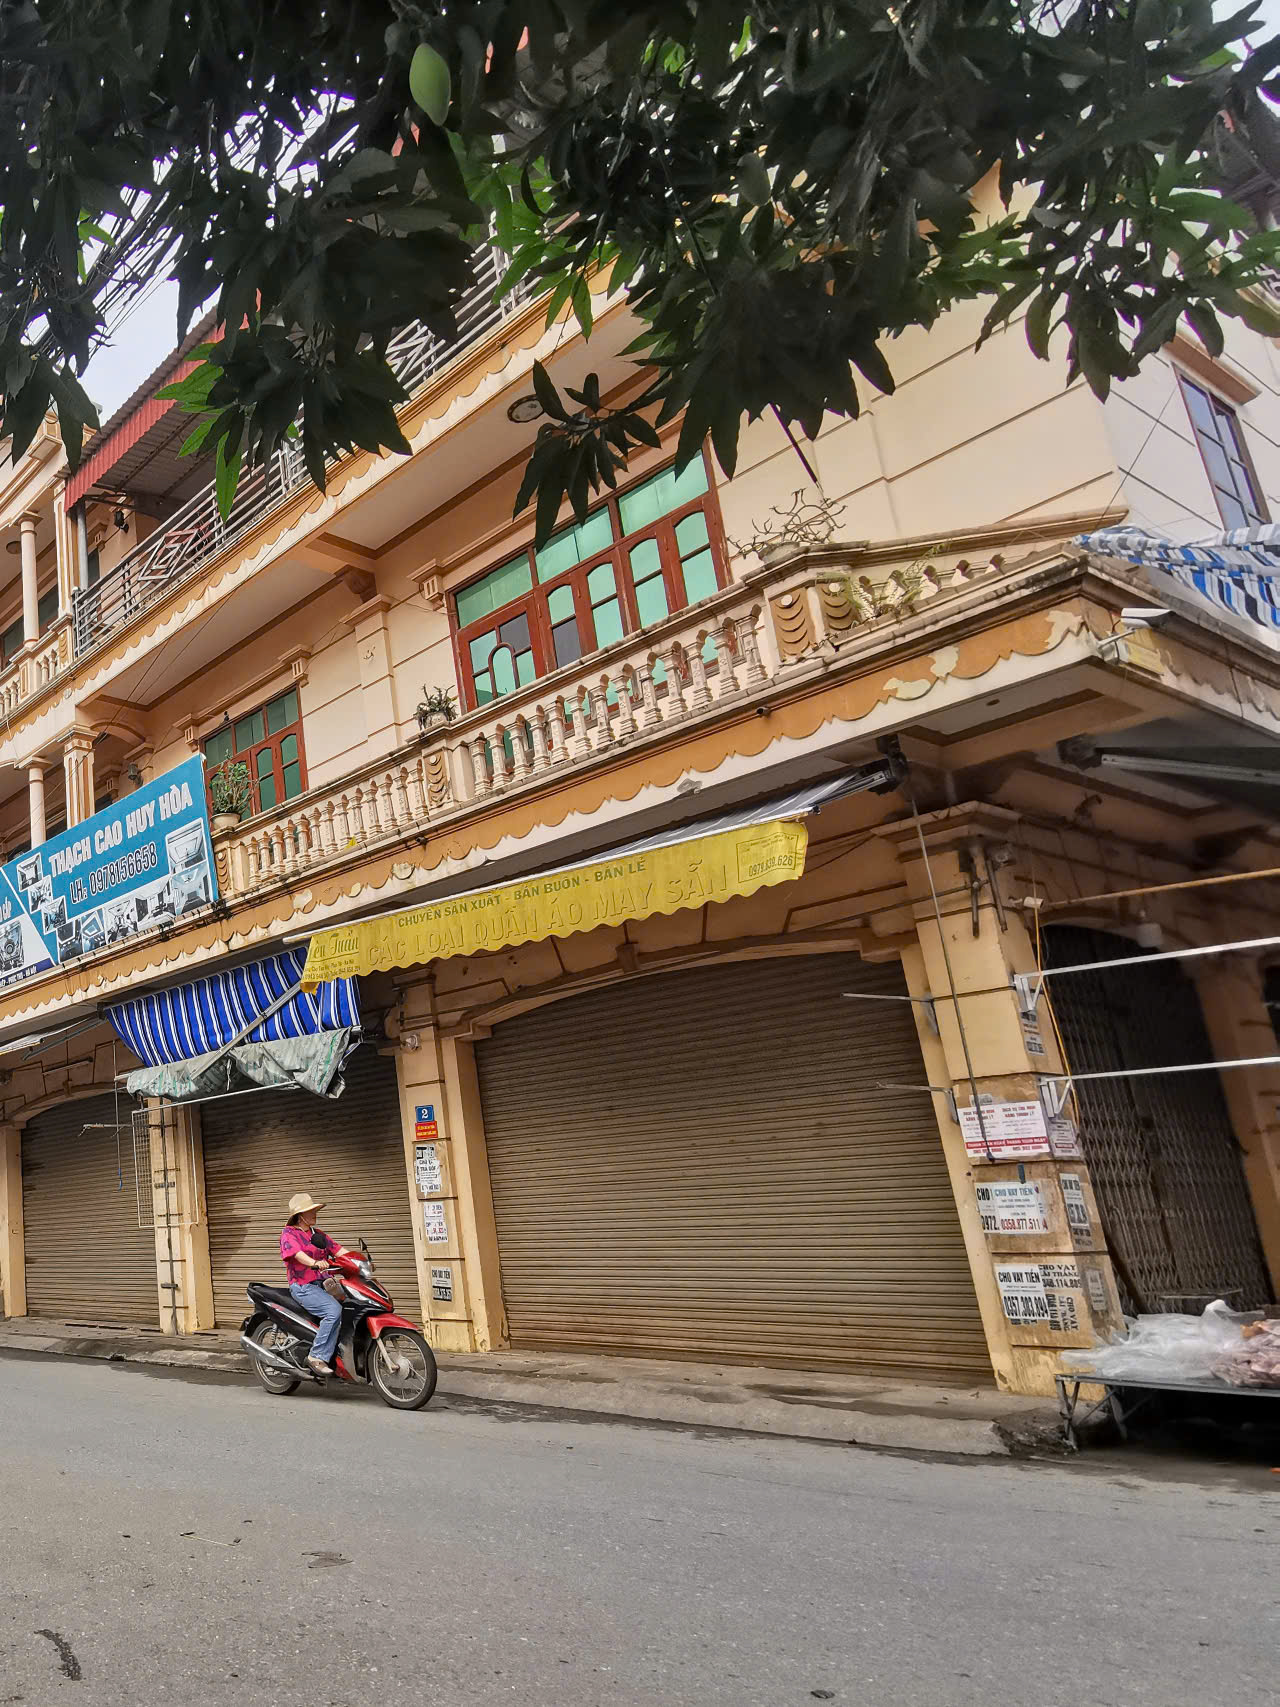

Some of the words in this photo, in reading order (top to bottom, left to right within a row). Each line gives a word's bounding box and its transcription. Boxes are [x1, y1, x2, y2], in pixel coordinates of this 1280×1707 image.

[48, 836, 92, 878] THẠCH
[94, 820, 123, 854] CAO
[125, 800, 155, 839] HUY
[158, 782, 193, 821] HÒA
[89, 841, 158, 896] 0978156658
[398, 907, 442, 928] CHUYÊN
[444, 901, 468, 917] SẢN
[514, 883, 540, 900] BÁN
[544, 873, 580, 894] BUÔN
[594, 864, 624, 882] BÁN
[367, 936, 407, 966] CÁC
[546, 897, 583, 930] ÁO
[593, 882, 653, 920] MAY
[421, 1108, 429, 1119] 2
[976, 1188, 990, 1201] CHO
[994, 1188, 1007, 1197] CHO
[998, 1272, 1012, 1283] CHO
[1012, 1272, 1024, 1283] VAY
